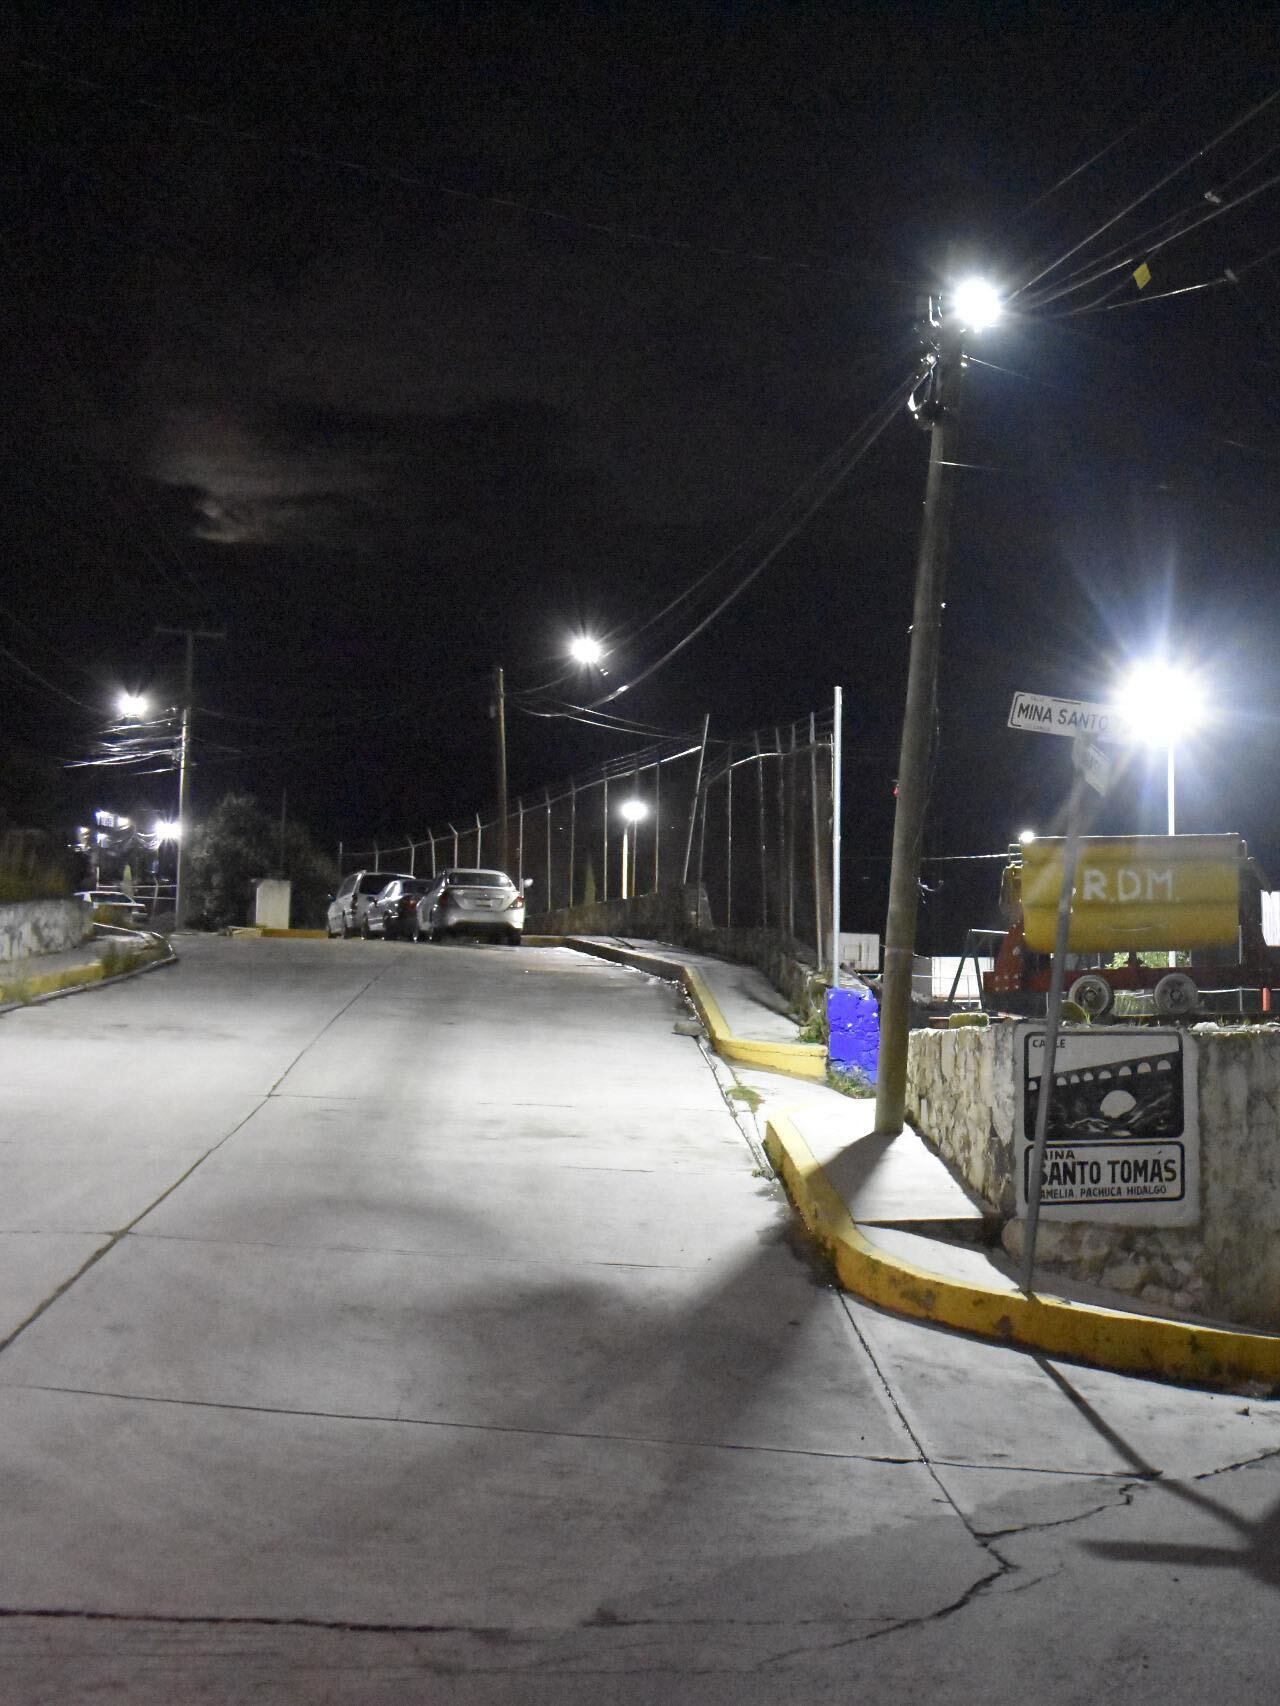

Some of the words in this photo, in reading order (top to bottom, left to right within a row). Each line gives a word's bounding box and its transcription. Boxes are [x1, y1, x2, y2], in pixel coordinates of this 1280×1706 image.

[1018, 702, 1052, 724] MINA
[1058, 709, 1109, 732] SANTO
[1032, 1039, 1066, 1049] CALE
[1042, 1149, 1076, 1161] INA
[1080, 1186, 1122, 1198] PACHUCA
[1126, 1184, 1167, 1197] HIDALGO
